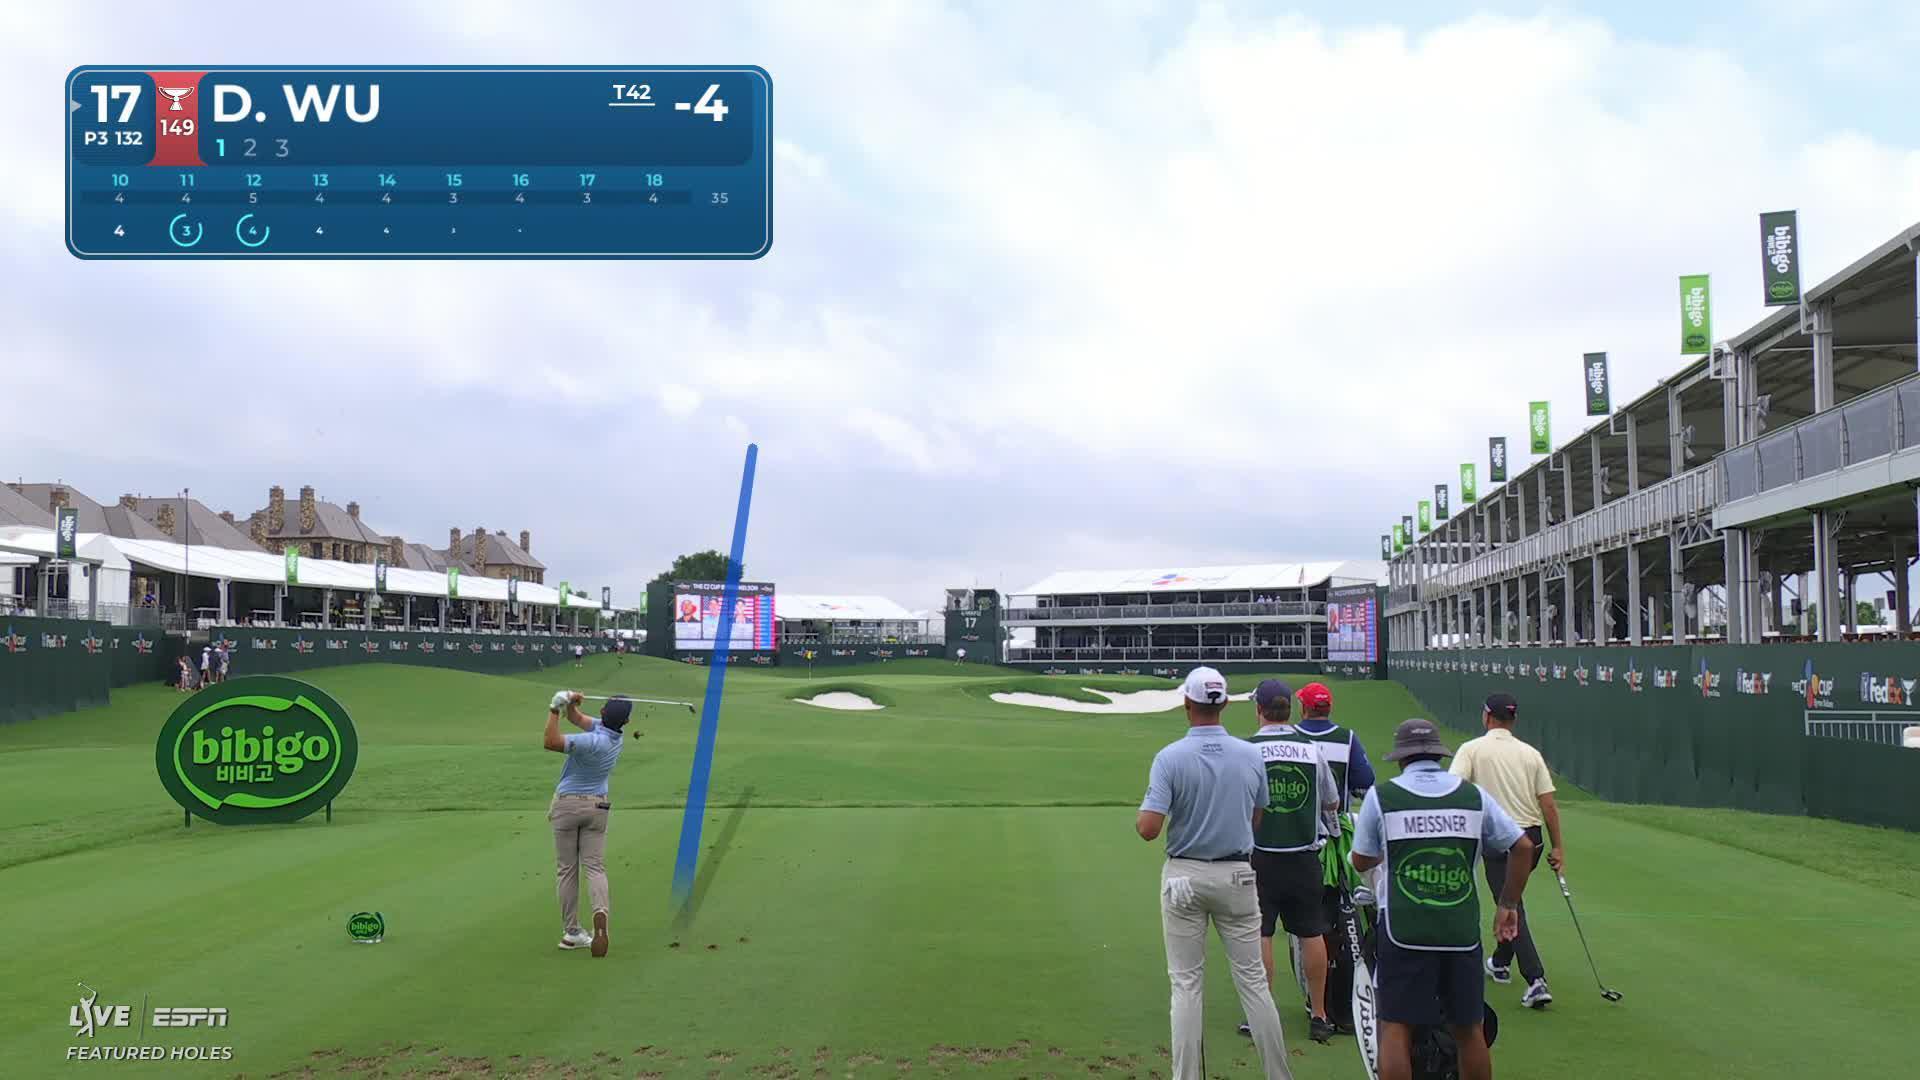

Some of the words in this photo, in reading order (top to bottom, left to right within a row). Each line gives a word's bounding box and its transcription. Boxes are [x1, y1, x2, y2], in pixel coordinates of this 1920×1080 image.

[1771, 226, 1793, 274] bibigo
[1687, 287, 1704, 327] bibigo
[1591, 362, 1605, 395] bibigo
[964, 616, 978, 629] 17
[1742, 671, 1763, 694] FedEx
[1799, 679, 1808, 698] CJ
[1818, 679, 1833, 697] CUP
[1870, 676, 1904, 705] FedEx
[192, 725, 331, 775] bibigo
[215, 764, 275, 784] 비비고
[1403, 814, 1467, 834] MEISSNER
[351, 920, 379, 933] bibigo
